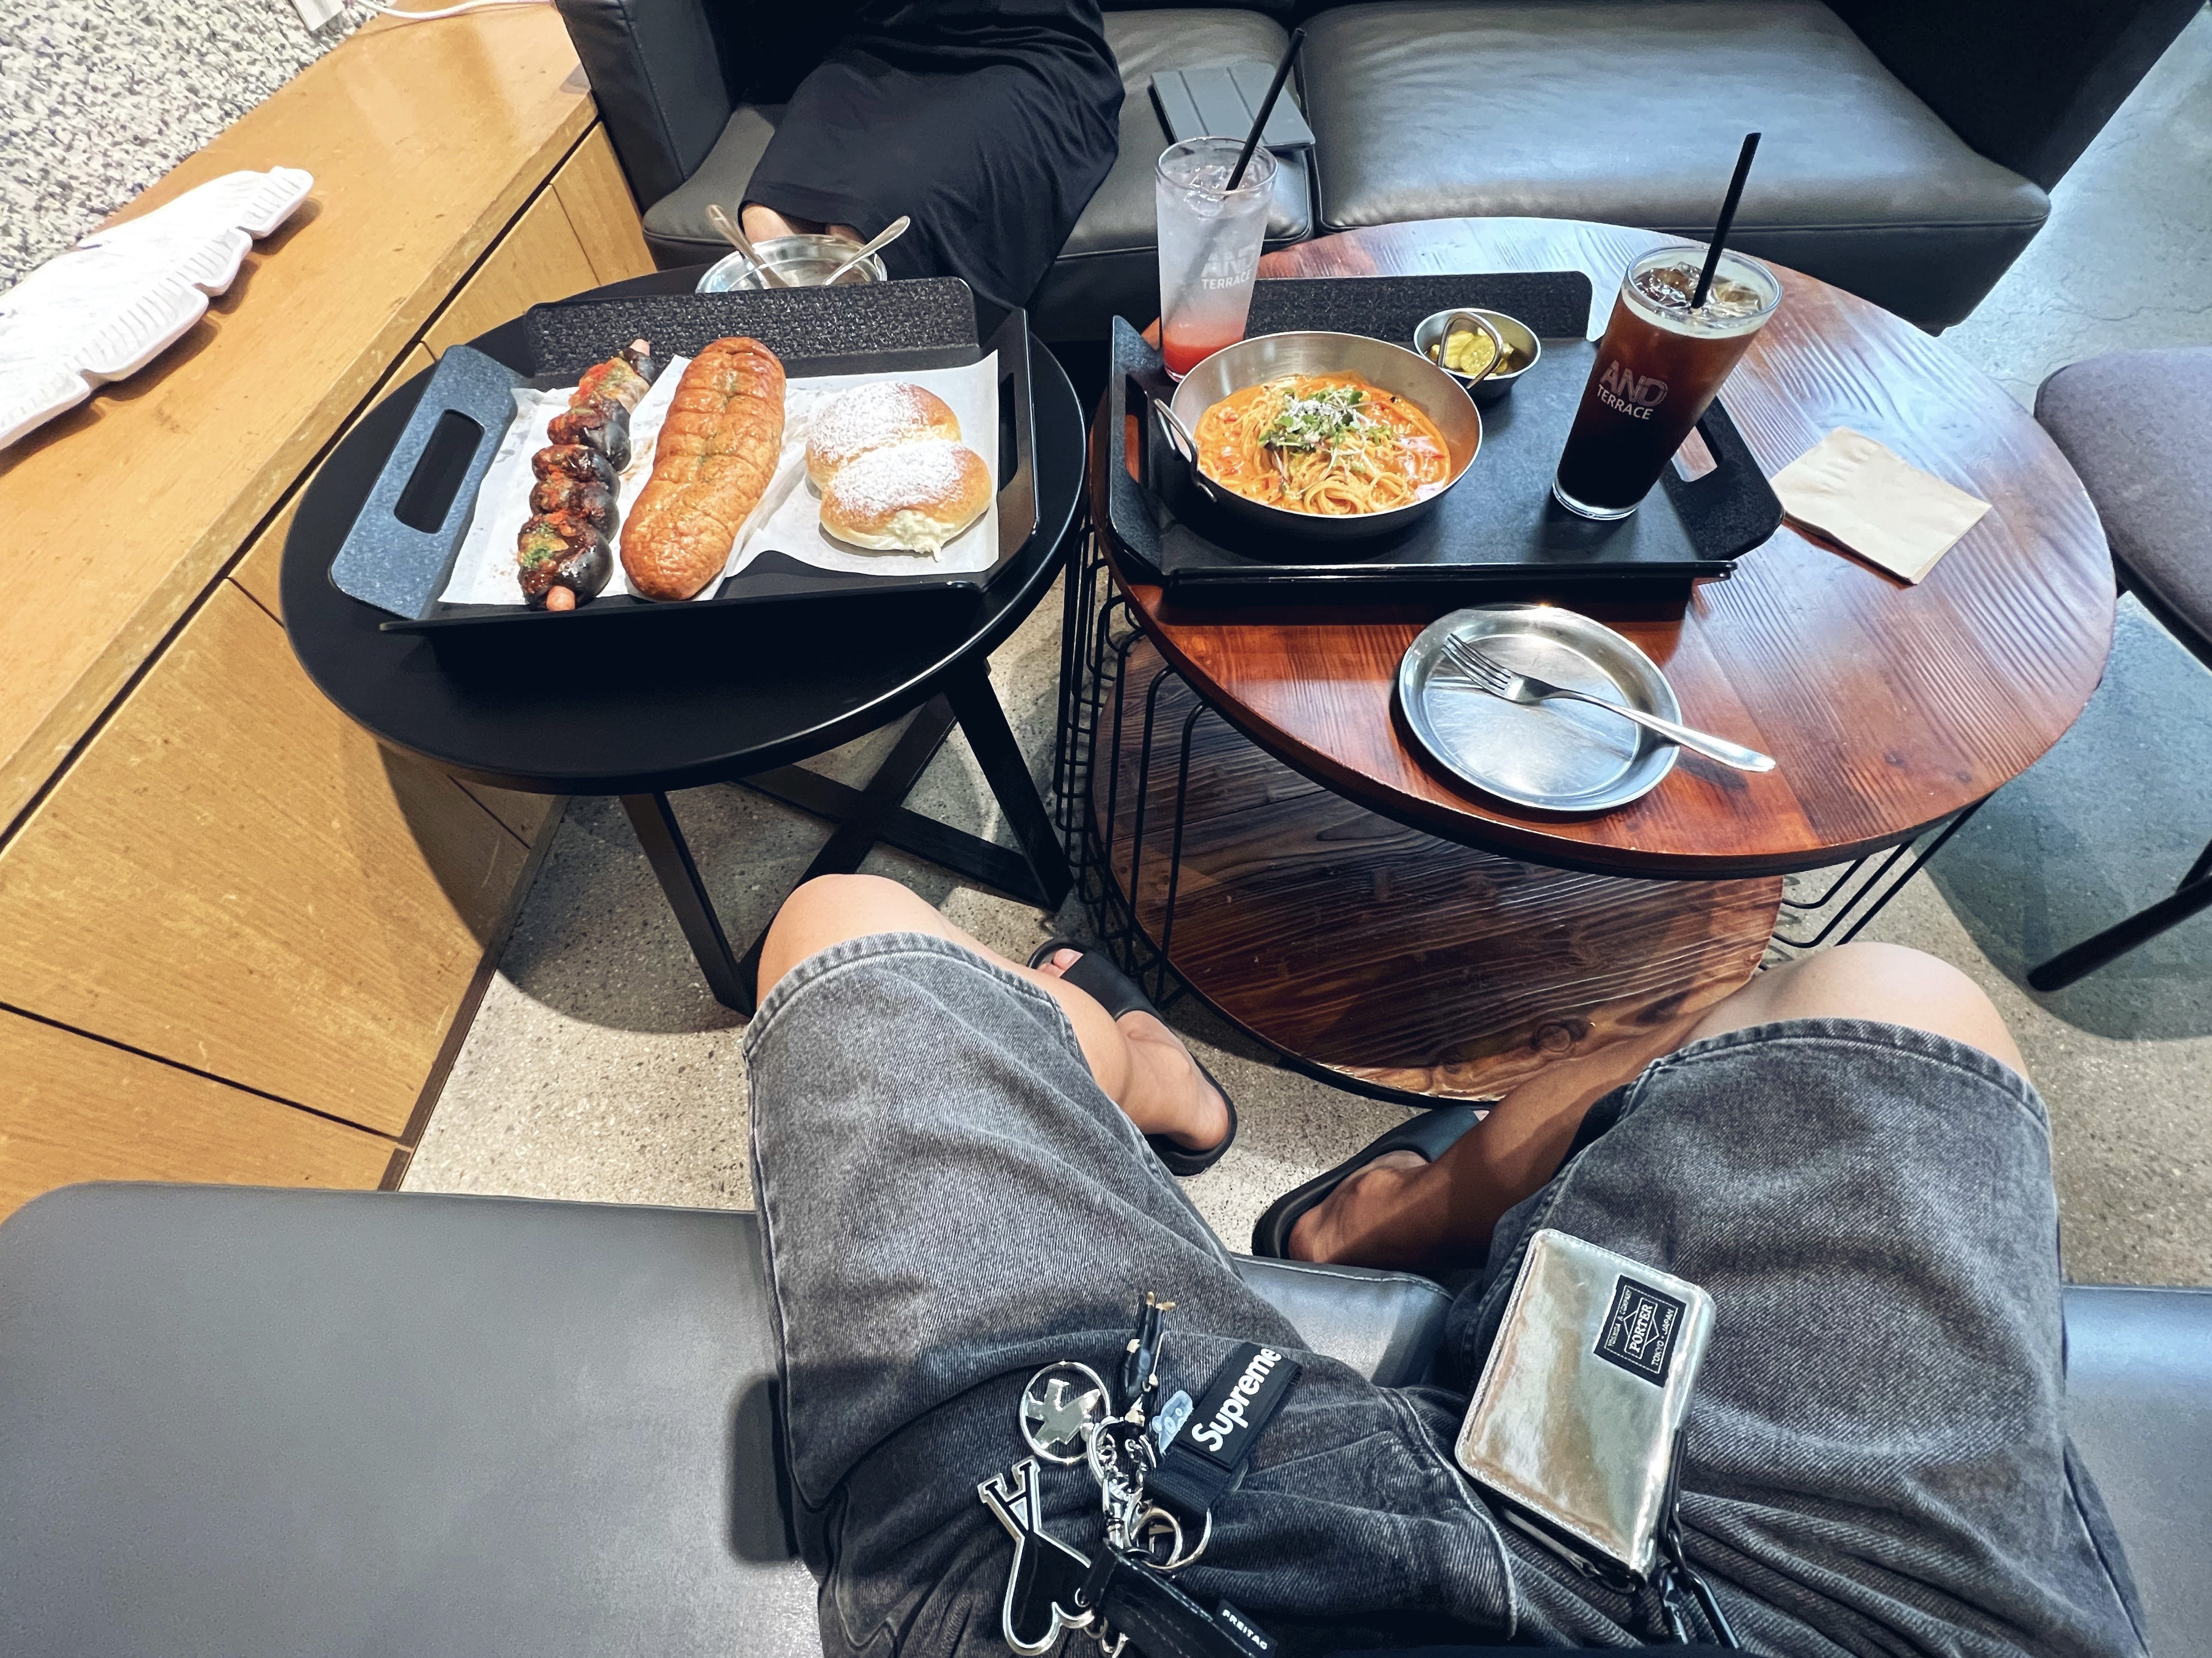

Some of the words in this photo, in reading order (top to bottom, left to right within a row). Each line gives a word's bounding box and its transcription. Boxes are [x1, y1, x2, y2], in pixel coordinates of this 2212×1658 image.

[1201, 268, 1251, 289] TERRACE
[1597, 384, 1653, 420] TERRACE
[1600, 360, 1668, 407] AND
[1629, 1304, 1653, 1353] PORTER
[1651, 1340, 1665, 1365] TOKYO
[1662, 1309, 1674, 1335] JAPAN
[1191, 1348, 1282, 1452] Supreme
[1222, 1609, 1268, 1650] FREITAG
